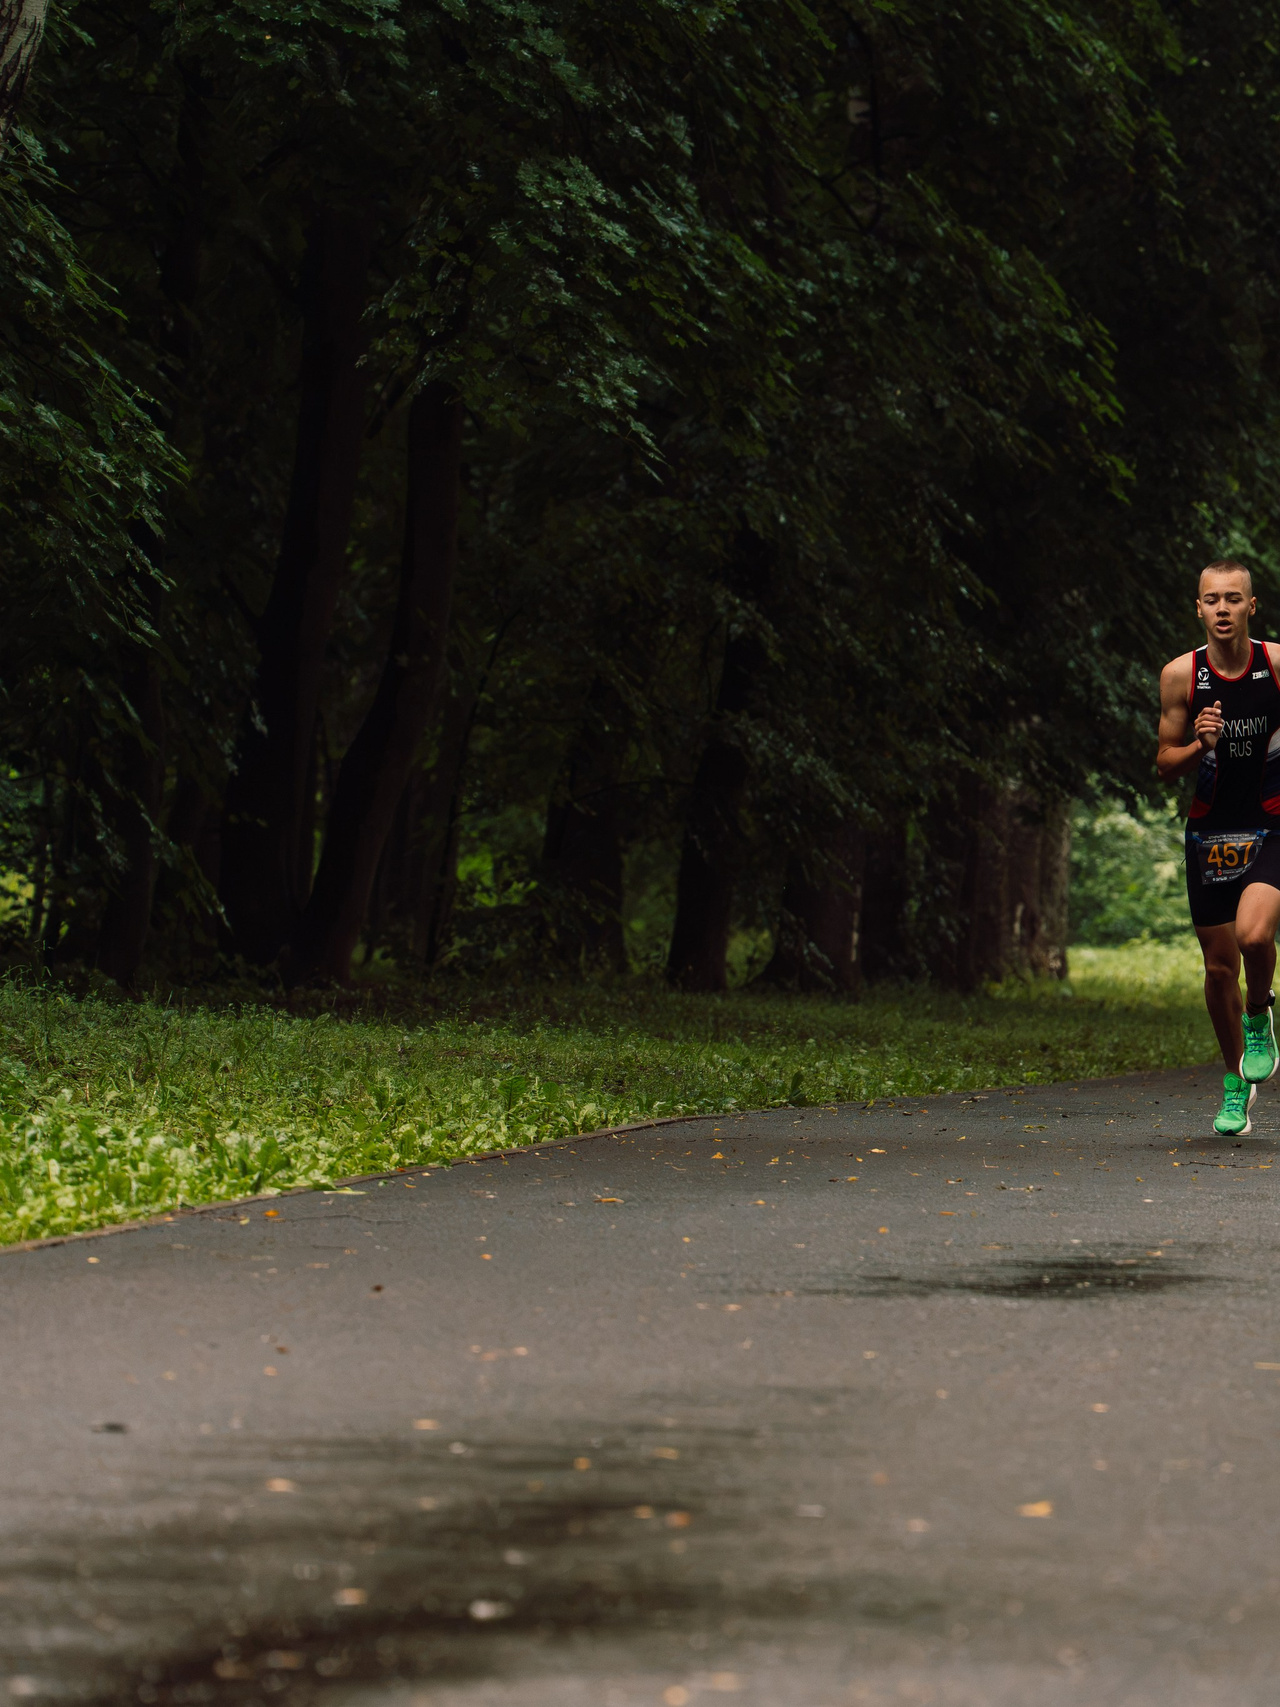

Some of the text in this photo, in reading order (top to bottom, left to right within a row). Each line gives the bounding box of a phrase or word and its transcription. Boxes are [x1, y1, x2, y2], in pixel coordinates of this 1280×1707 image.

[1220, 716, 1267, 738] KYKHNYI
[1229, 741, 1253, 758] RUS
[1207, 841, 1254, 868] 457
